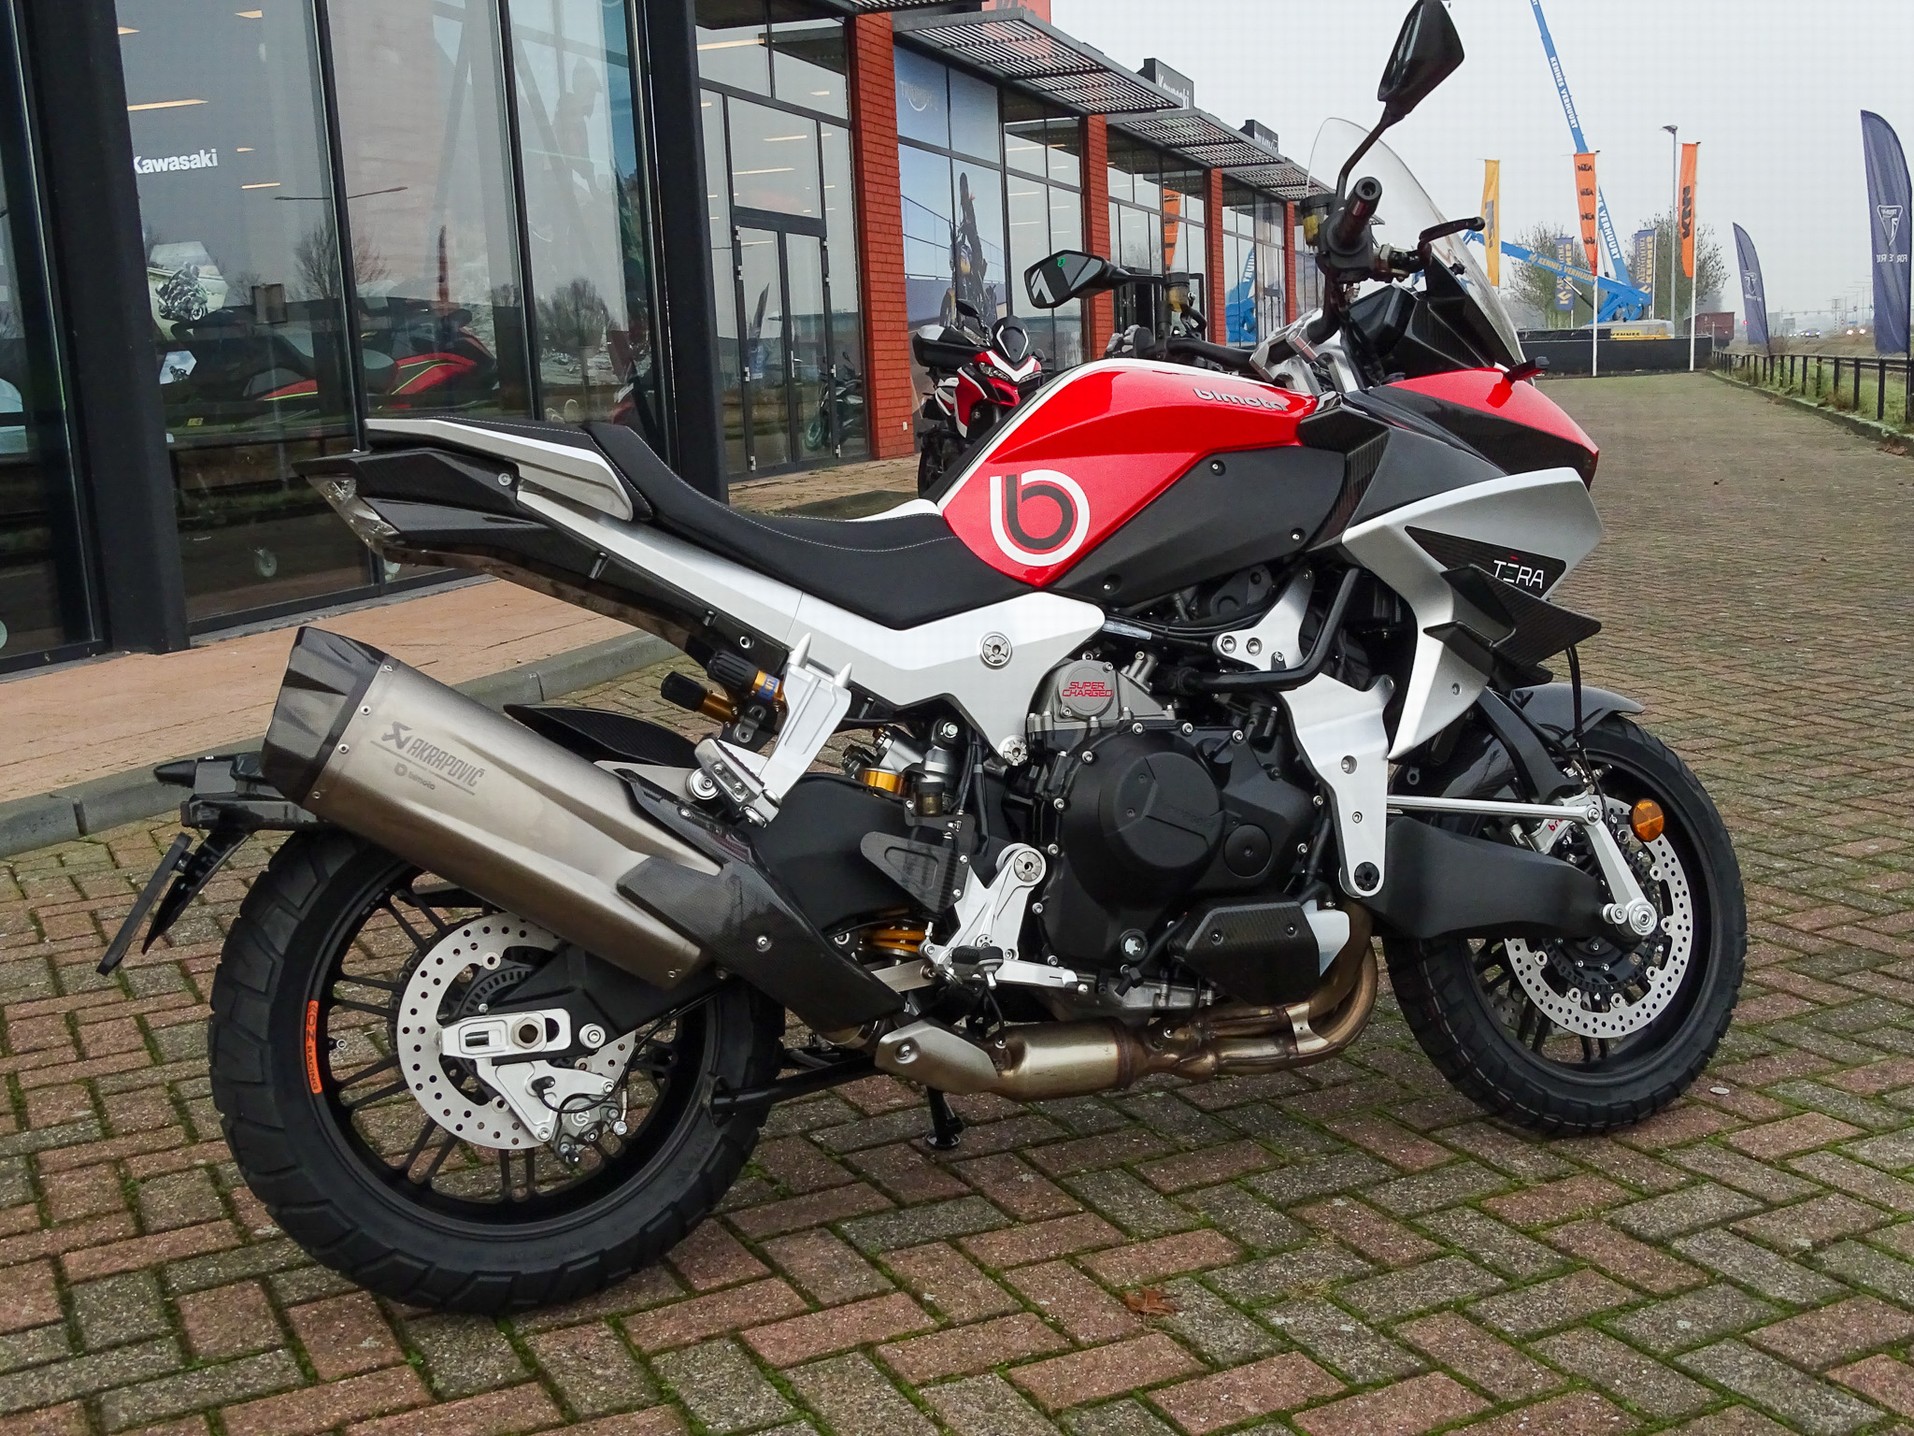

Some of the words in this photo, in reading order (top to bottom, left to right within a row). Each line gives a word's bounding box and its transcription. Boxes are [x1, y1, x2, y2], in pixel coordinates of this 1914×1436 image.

[1549, 56, 1566, 88] KENNES
[1560, 88, 1579, 128] VERHUURT
[133, 148, 218, 174] Kawasaki
[1599, 209, 1620, 260] VERHUURT
[1193, 387, 1288, 411] bimota
[1062, 689, 1113, 698] CHARGED
[1069, 682, 1105, 690] SUPER
[307, 1045, 319, 1090] RACING
